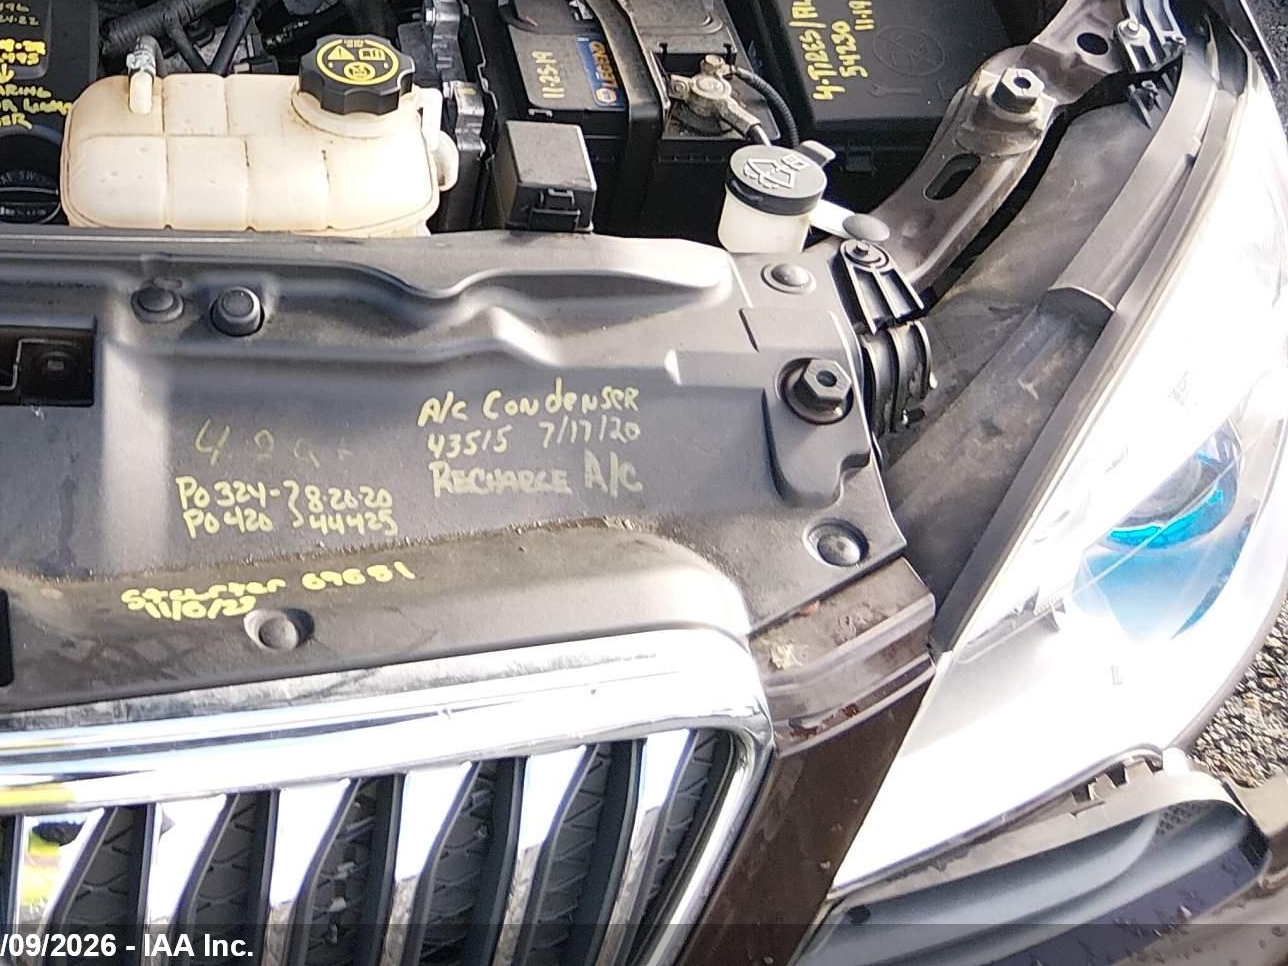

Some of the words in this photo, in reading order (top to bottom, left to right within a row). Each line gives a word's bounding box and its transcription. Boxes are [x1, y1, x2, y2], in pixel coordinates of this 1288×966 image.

[417, 390, 469, 427] A/C
[427, 424, 513, 460] 43515
[538, 414, 641, 450] 7/17/20
[584, 448, 644, 499] A/C
[308, 508, 399, 537] 44425
